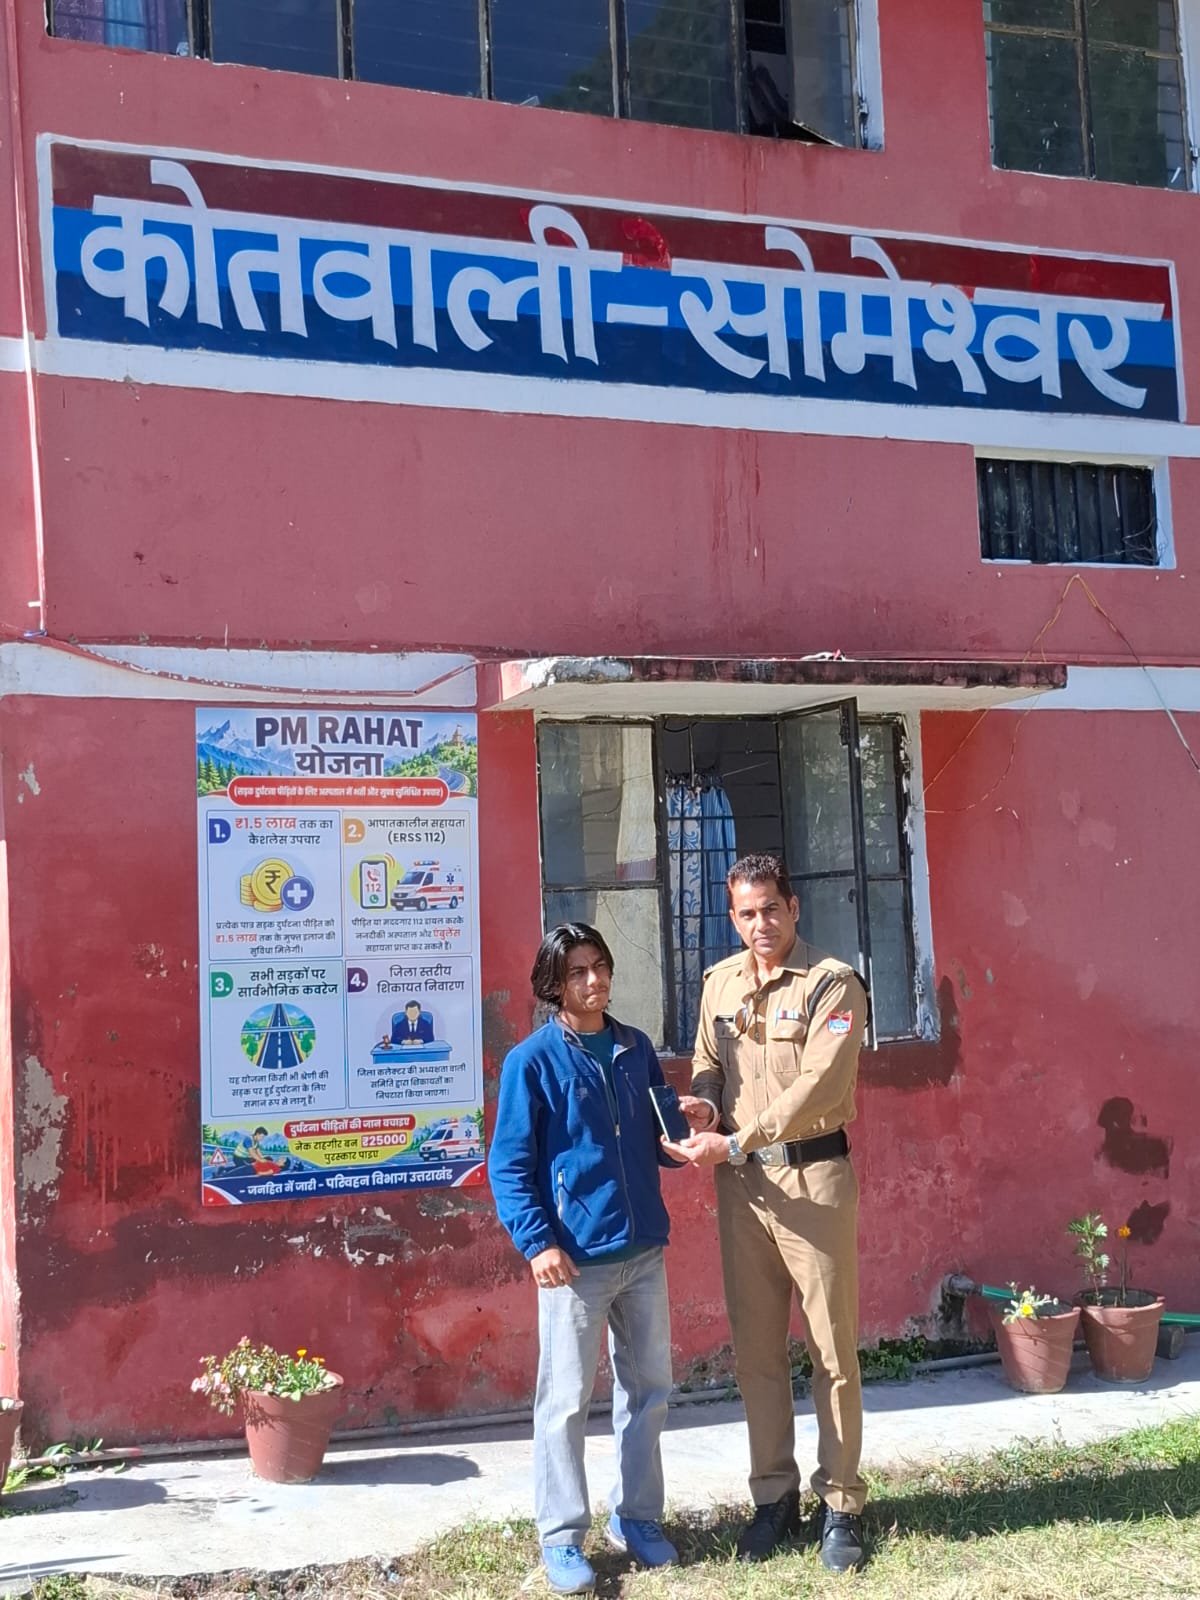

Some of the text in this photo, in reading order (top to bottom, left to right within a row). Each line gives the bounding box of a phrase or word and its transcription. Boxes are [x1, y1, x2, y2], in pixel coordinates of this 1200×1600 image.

[79, 158, 1167, 410] कोतवाली-सोमेश्वर
[255, 716, 423, 748] PM RAHAT
[295, 744, 384, 776] योजना
[265, 817, 297, 830] लाख
[299, 819, 317, 829] तक
[319, 819, 333, 829] का
[368, 816, 465, 828] आपातकालीन सहायता
[214, 823, 226, 839] 1.
[348, 824, 362, 838] 2.
[387, 830, 445, 844] (ERSS 112)
[289, 834, 320, 845] उपचार
[365, 883, 382, 893] 112
[413, 918, 423, 926] 112
[250, 966, 326, 983] सभी सड़कों पर
[389, 963, 452, 977] जिला स्तरीय
[215, 977, 230, 992] 3.
[350, 972, 366, 987] 4.
[377, 979, 465, 993] शिकायत निवारण
[302, 981, 338, 995] कवरेज
[289, 1121, 319, 1137] दुर्घटना
[321, 1118, 347, 1134] पीड़ितों
[349, 1118, 361, 1129] की
[363, 1118, 381, 1128] जान
[295, 1140, 312, 1151] नेक
[313, 1138, 342, 1150] राहगीर
[344, 1139, 358, 1148] बन
[324, 1150, 356, 1165] पुरस्कार
[247, 1181, 283, 1195] जनहित
[284, 1180, 294, 1192] में
[295, 1178, 317, 1191] जारी
[325, 1173, 370, 1189] परिवहन
[372, 1170, 407, 1186] विभाग
[409, 1166, 453, 1182] उत्तराखंड
